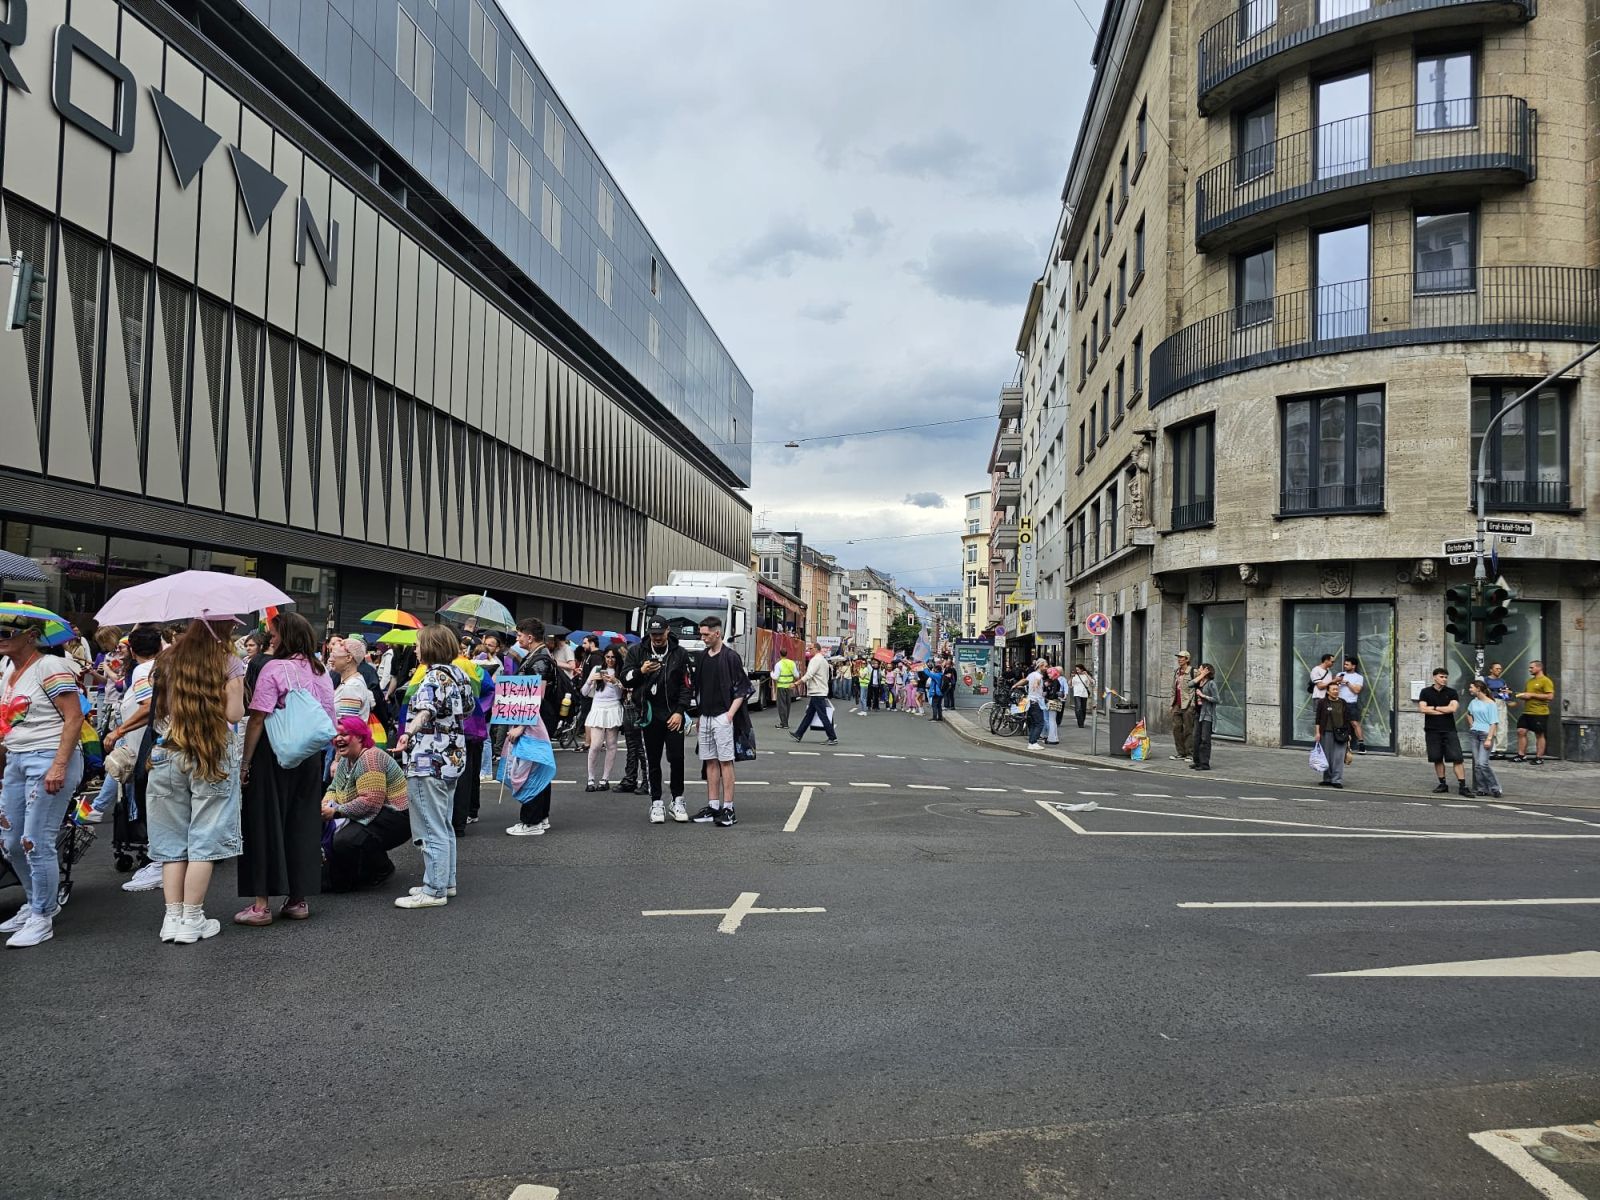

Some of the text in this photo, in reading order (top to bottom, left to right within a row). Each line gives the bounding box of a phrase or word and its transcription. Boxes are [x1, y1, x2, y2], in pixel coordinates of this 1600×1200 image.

[1489, 523, 1530, 532] Graf-Adolf-Straße
[1447, 542, 1472, 552] Oststraße
[1024, 545, 1032, 587] HOTEL
[499, 679, 538, 699] TRANS
[495, 700, 539, 722] RIGHTS
